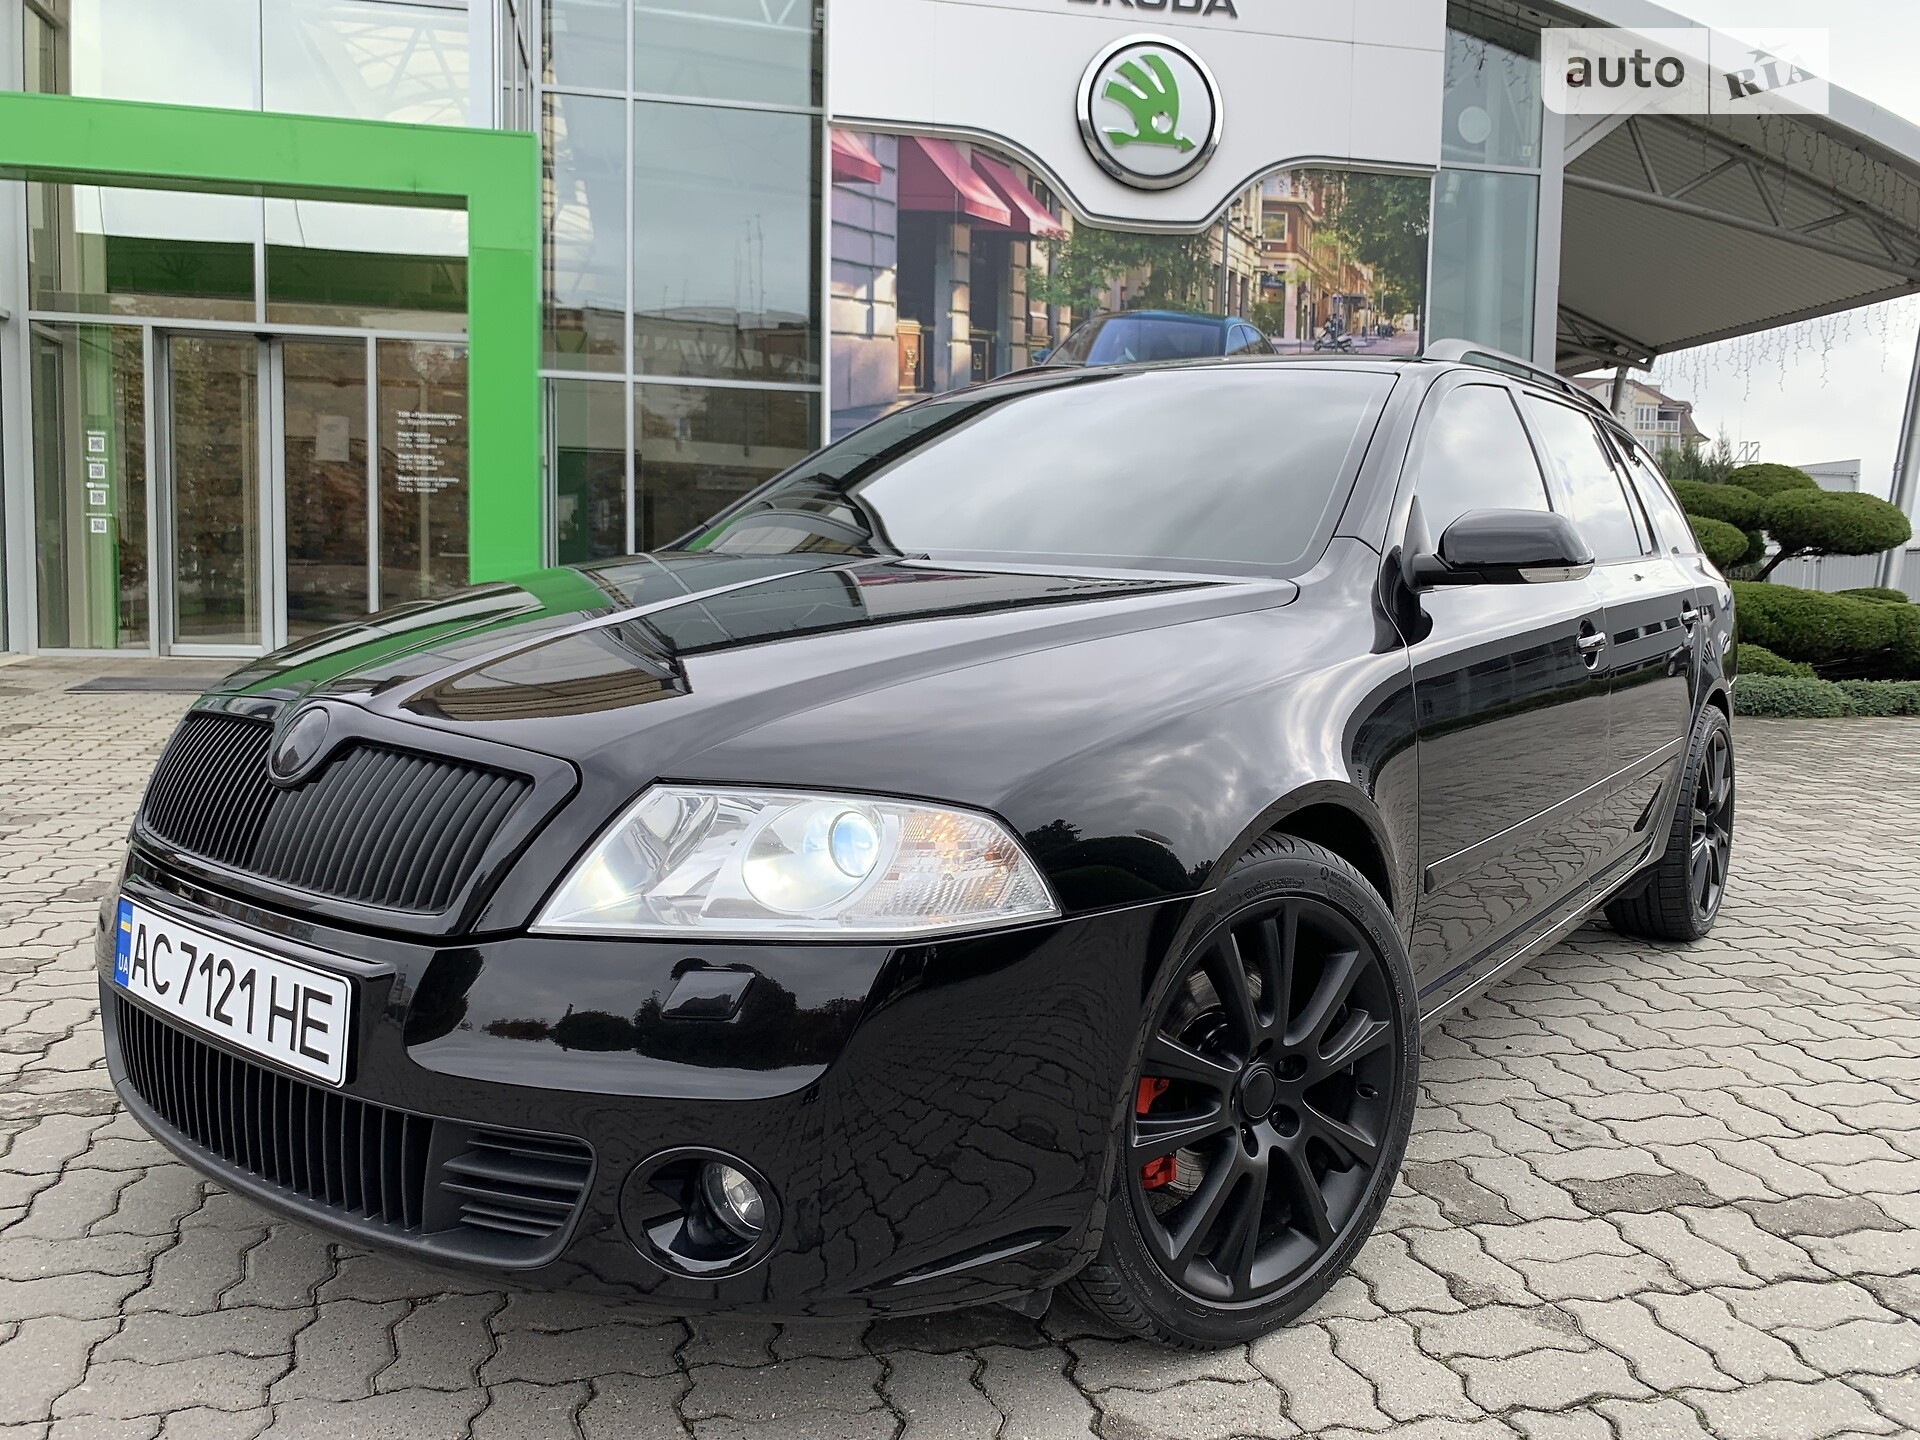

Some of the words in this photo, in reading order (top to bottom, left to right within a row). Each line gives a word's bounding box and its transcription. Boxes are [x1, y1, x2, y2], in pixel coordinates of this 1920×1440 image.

[118, 952, 129, 975] UA
[131, 923, 173, 995] AC
[178, 941, 256, 1035] 7121
[267, 975, 333, 1065] HE
